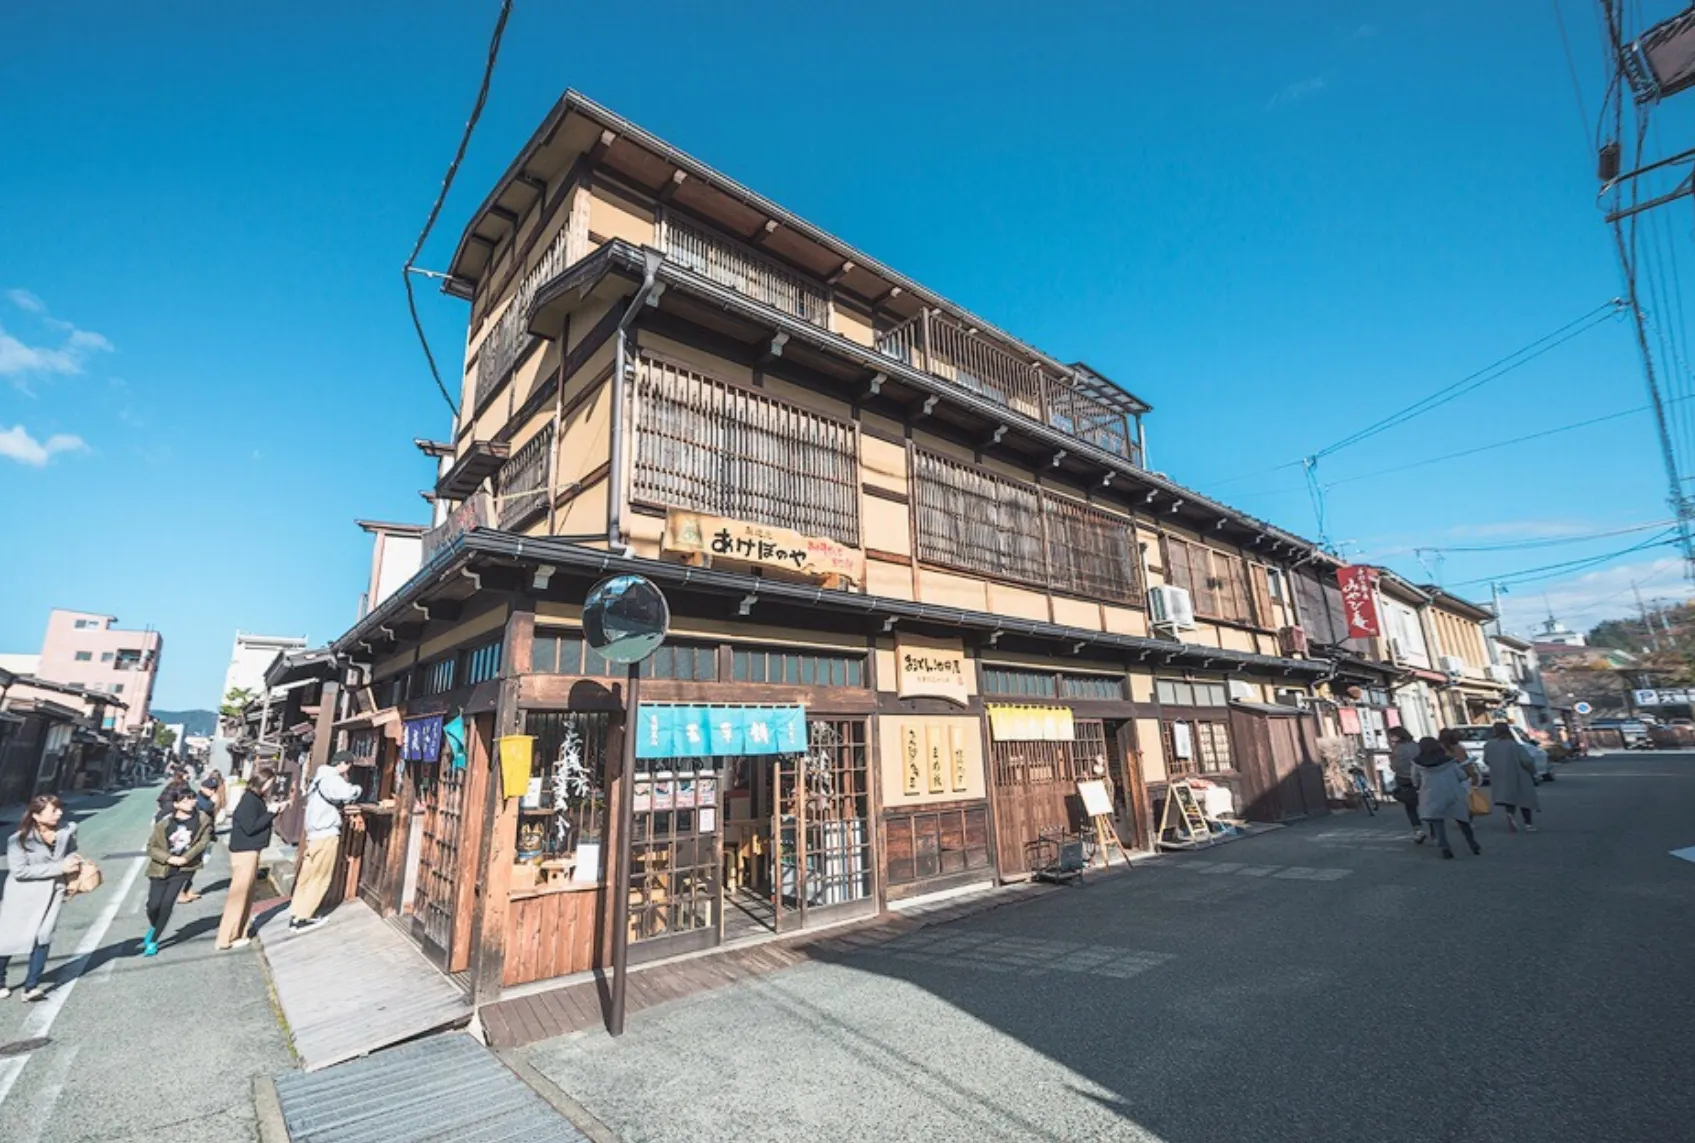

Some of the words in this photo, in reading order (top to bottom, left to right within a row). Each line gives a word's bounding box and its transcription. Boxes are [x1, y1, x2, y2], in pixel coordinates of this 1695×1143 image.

[711, 528, 807, 567] あけぼのや
